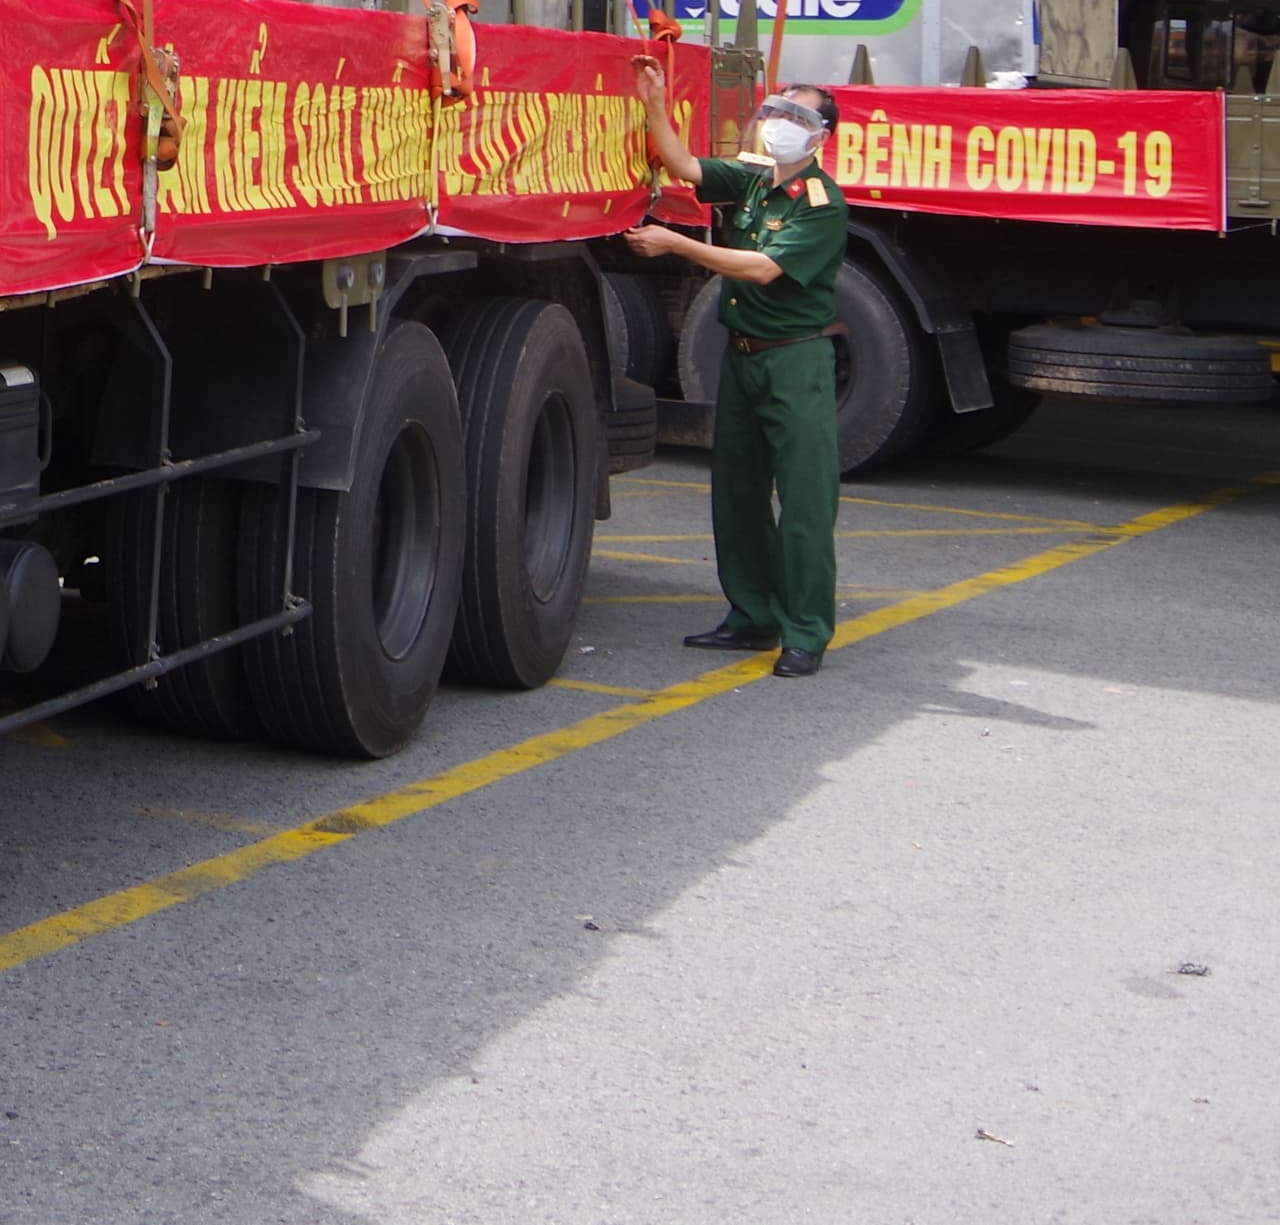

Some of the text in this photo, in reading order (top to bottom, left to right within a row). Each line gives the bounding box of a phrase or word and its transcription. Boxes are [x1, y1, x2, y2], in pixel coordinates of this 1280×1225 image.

[29, 23, 132, 242] QUYẾT
[214, 22, 298, 213] KIỂM
[966, 124, 1173, 198] COVID-19
